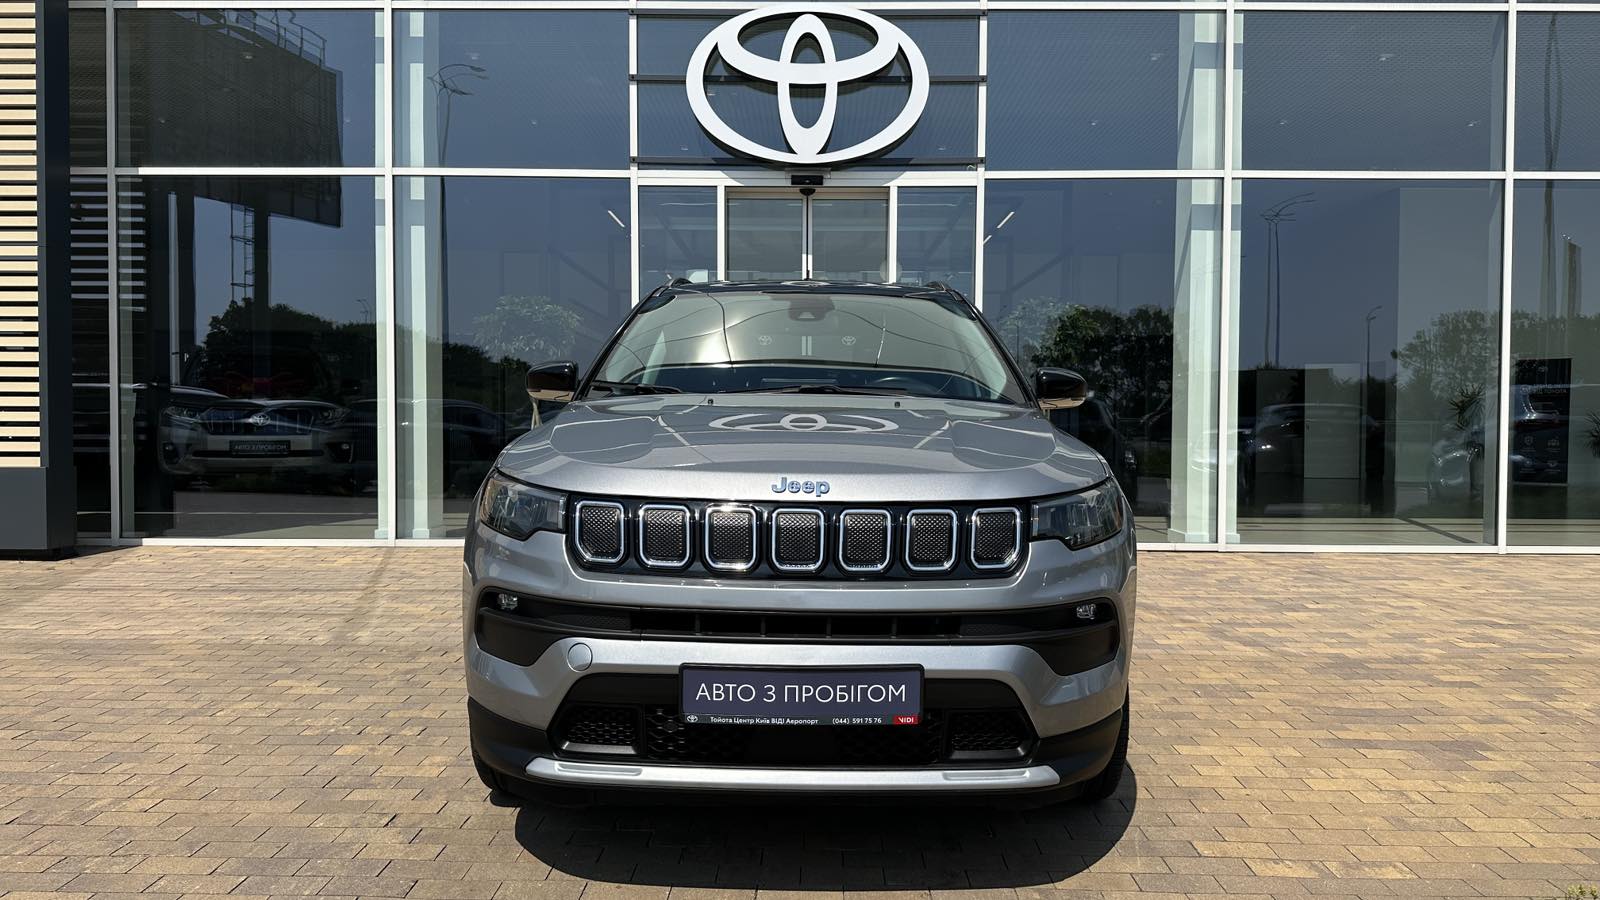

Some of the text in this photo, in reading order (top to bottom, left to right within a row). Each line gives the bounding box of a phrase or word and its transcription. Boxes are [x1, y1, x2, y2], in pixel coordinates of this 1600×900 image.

[771, 477, 830, 497] Jeep
[695, 683, 756, 702] АВТО
[784, 684, 906, 702] ПРОБІГОМ
[710, 716, 819, 726] Тойота Центр Київ ВІДІ Аеропорт
